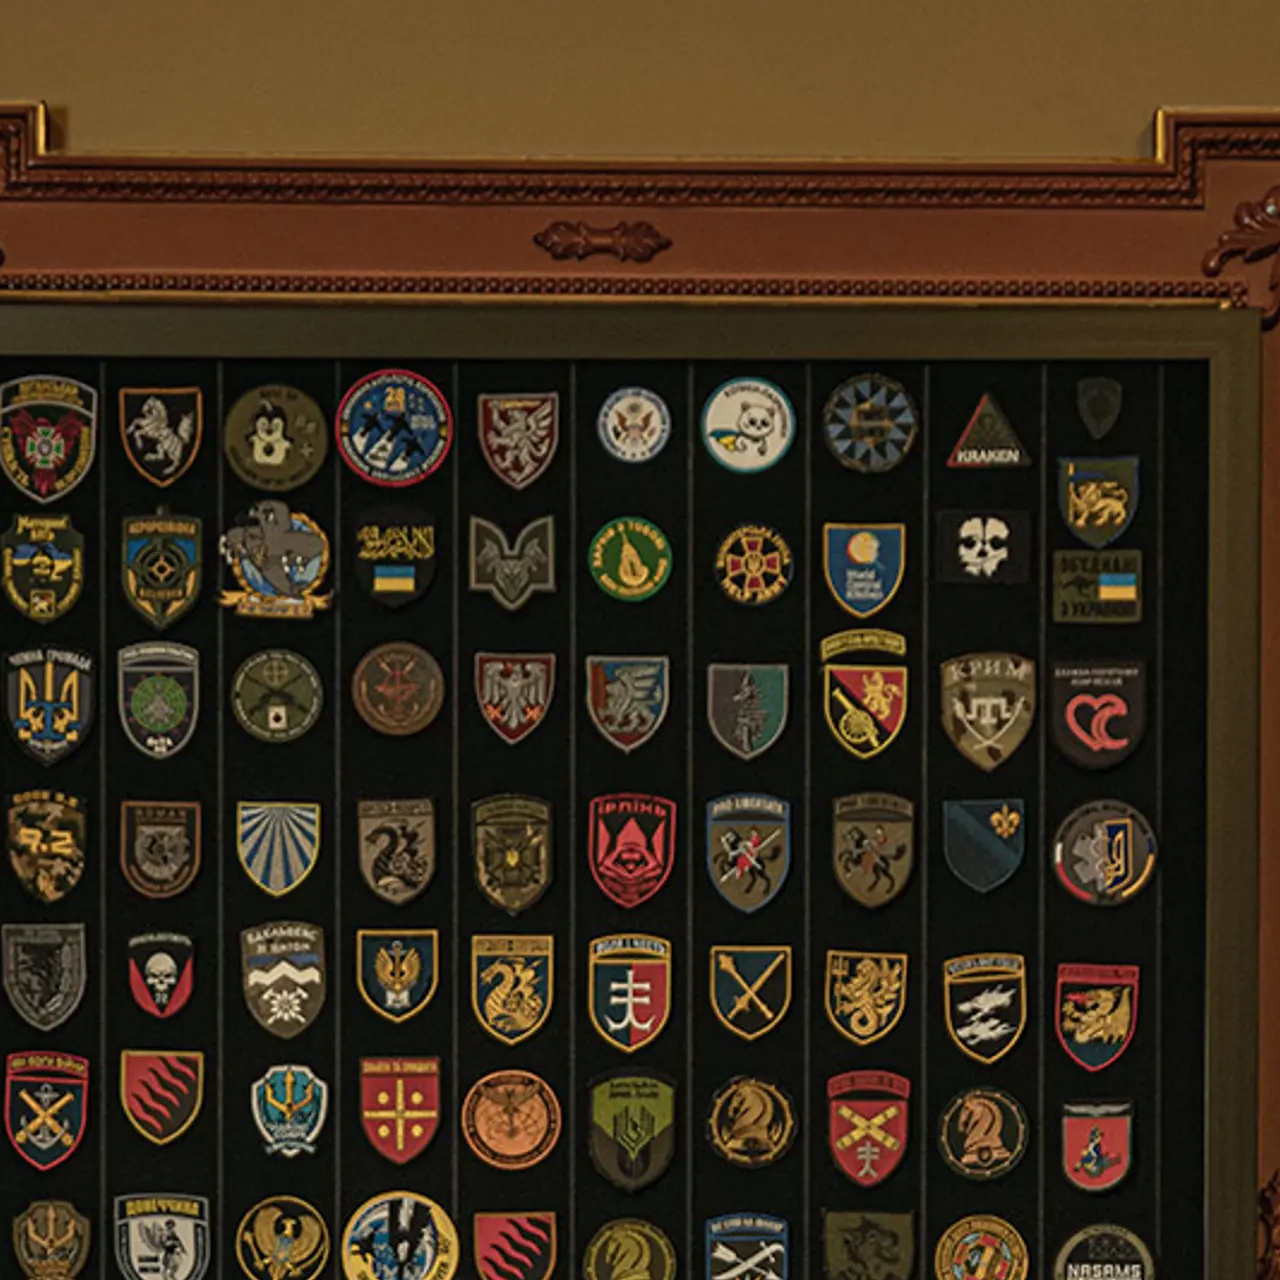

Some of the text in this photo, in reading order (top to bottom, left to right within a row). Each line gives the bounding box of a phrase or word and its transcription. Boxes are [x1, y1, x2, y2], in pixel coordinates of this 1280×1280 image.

[957, 448, 1021, 463] KRAKEN
[950, 658, 1028, 681] КРИМ
[597, 801, 666, 818] ІРПІНЬ
[1067, 1262, 1141, 1277] NASAMS
